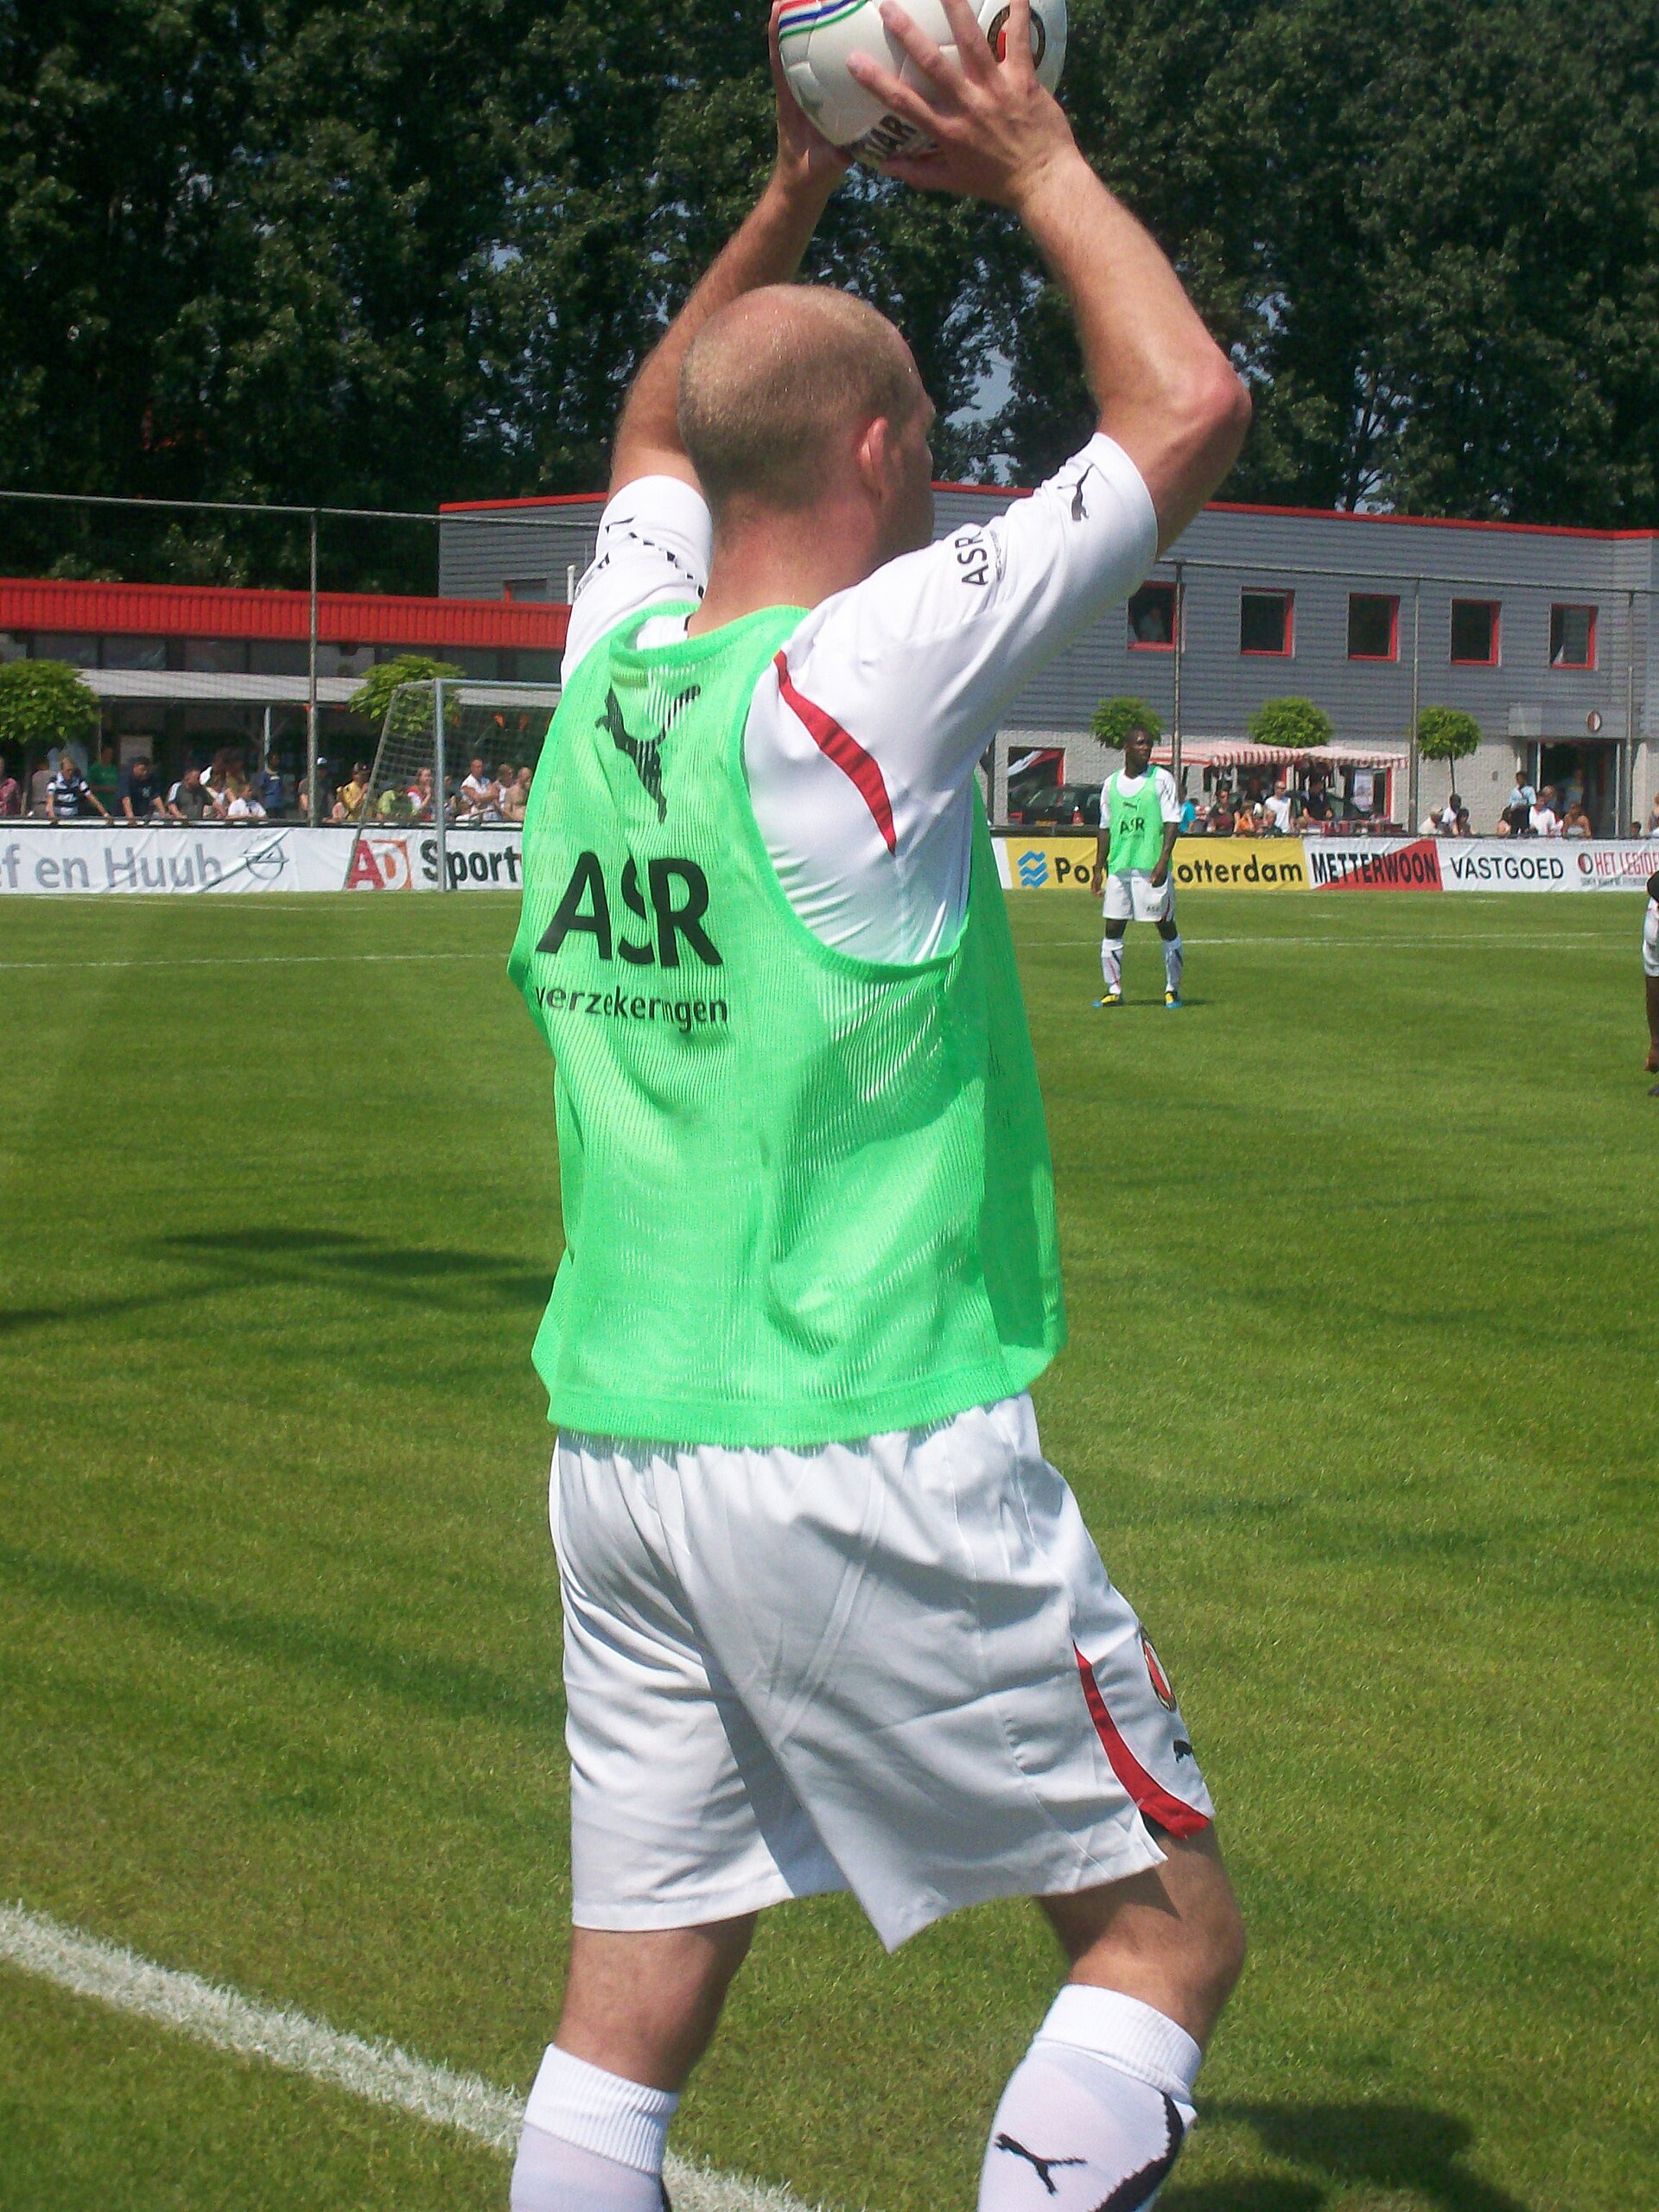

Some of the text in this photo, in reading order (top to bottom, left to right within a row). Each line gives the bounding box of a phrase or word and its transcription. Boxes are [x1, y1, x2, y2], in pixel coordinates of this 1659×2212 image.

[955, 530, 988, 585] ASR
[0, 843, 222, 888] f en Huuh
[346, 839, 523, 890] AD Sport
[1173, 855, 1304, 883] otterdam
[1311, 852, 1565, 884] METTERWOON VASTGOED
[1594, 852, 1617, 875] HET
[535, 851, 723, 969] ASR
